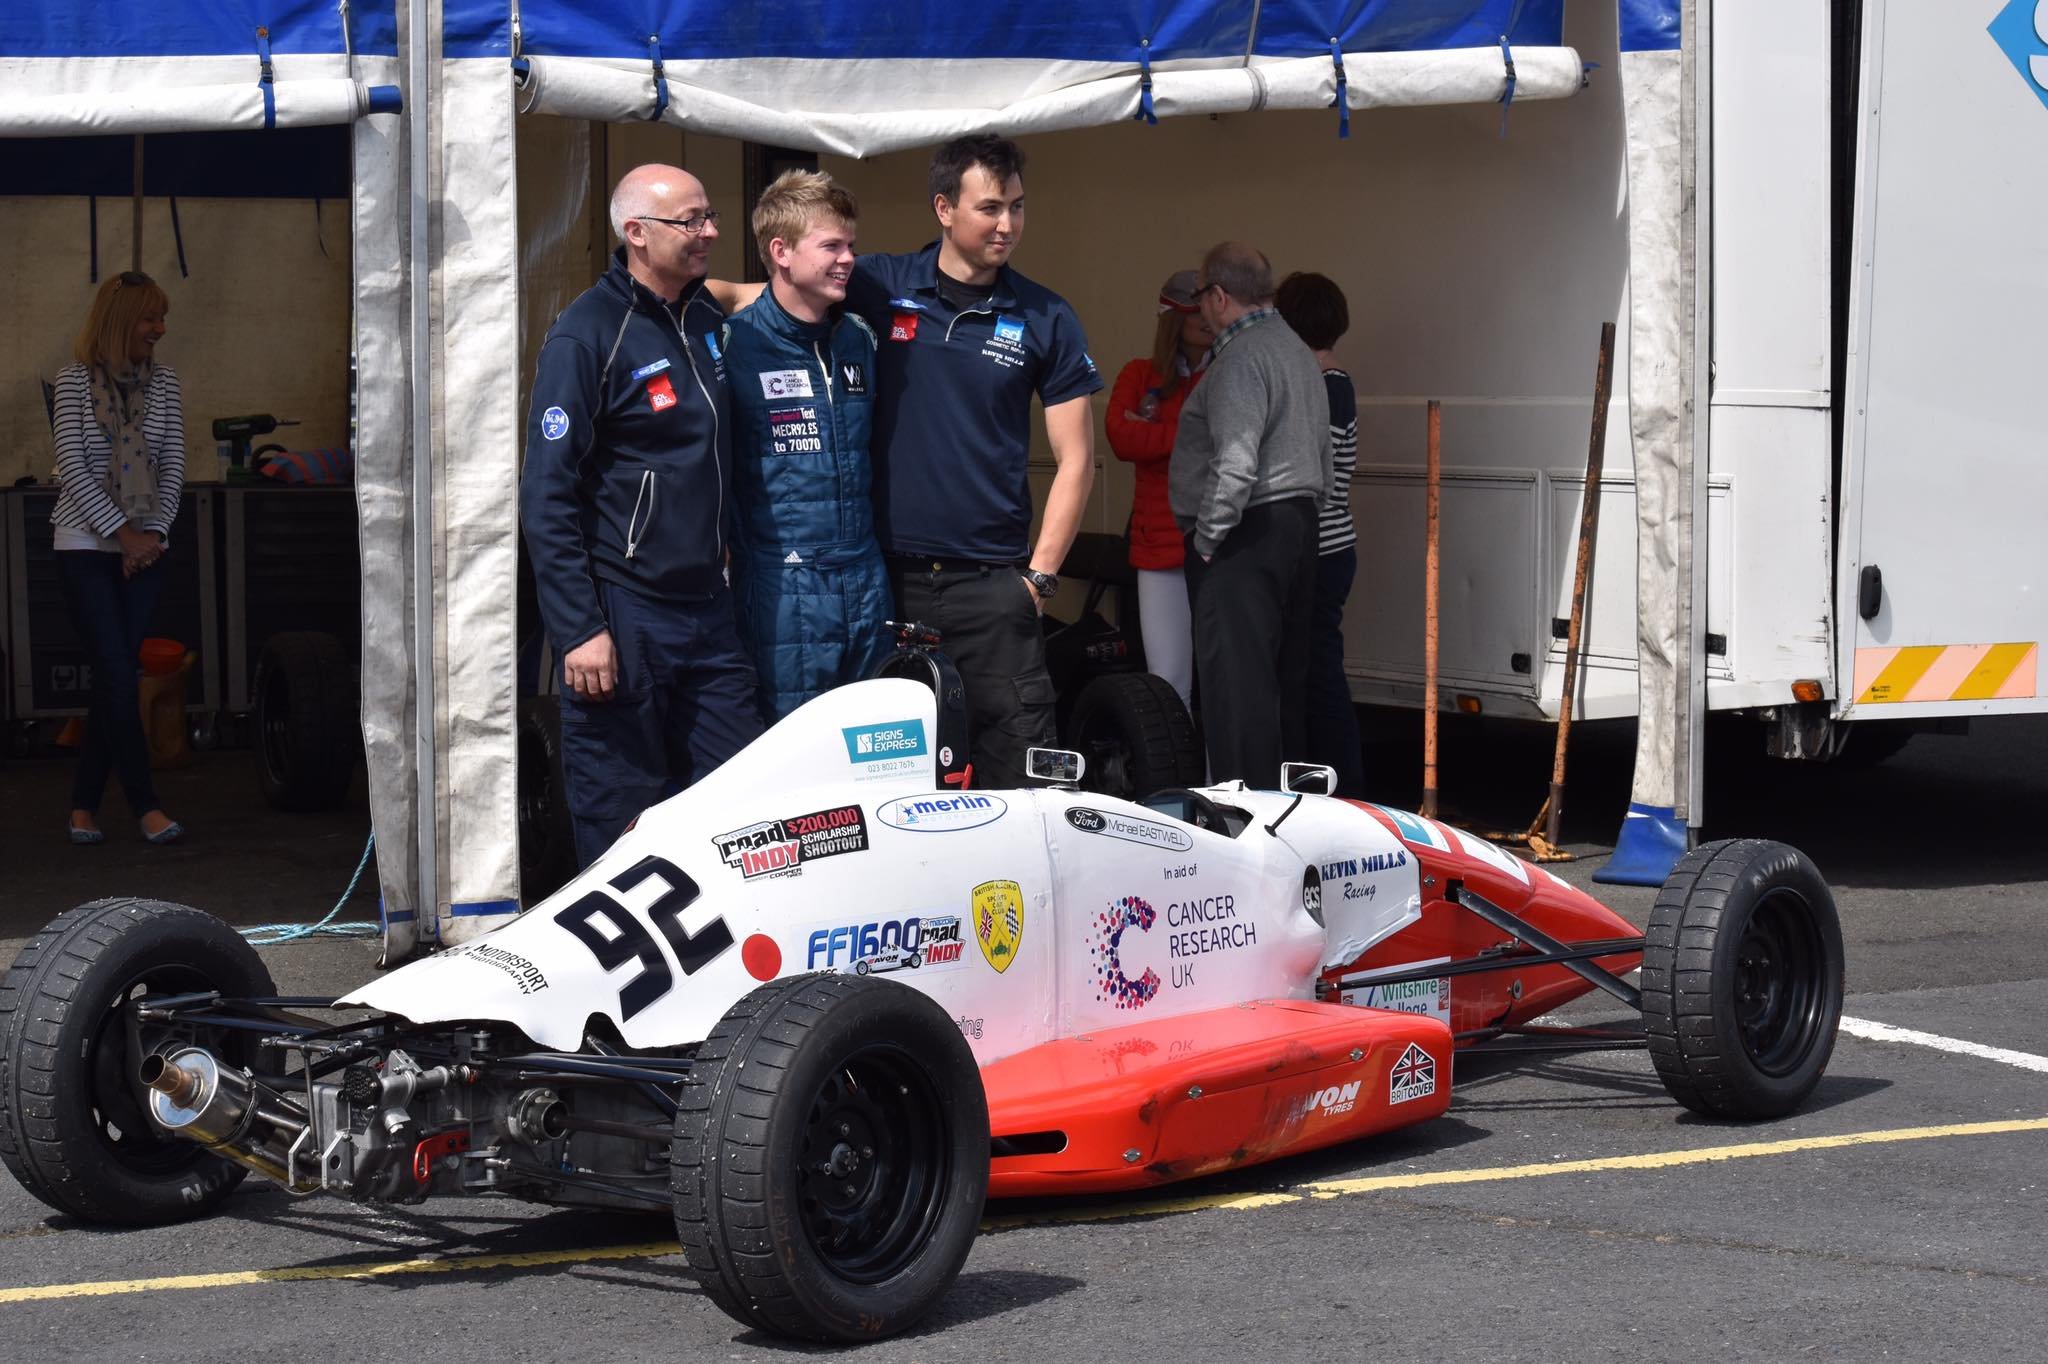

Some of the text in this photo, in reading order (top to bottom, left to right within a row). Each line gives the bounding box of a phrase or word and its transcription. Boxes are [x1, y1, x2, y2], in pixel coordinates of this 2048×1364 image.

[801, 407, 815, 420] Text
[772, 422, 818, 437] MECR92 £5
[774, 438, 820, 452] to 70070
[874, 729, 904, 743] SIGNS
[874, 737, 918, 752] EXPRESS
[868, 760, 916, 773] 023 8022 7676
[943, 750, 950, 762] E
[913, 794, 992, 814] merlin
[786, 808, 859, 835] $200,000
[1074, 810, 1186, 847] Ford Michael EASTWELL
[722, 821, 786, 857] road
[801, 824, 861, 845] SCHOLARSHIP
[804, 835, 864, 858] SHOOTOUT
[741, 841, 799, 876] INDY
[1321, 850, 1407, 882] KEVIN MILLS
[769, 867, 802, 880] COOPER
[1164, 863, 1198, 880] In aid of
[1304, 885, 1321, 910] ecs
[1342, 881, 1377, 901] Racing
[929, 915, 955, 927] mazda
[1167, 895, 1236, 928] CANCER
[554, 855, 735, 1023] 92
[807, 917, 920, 970] FF1600
[920, 921, 960, 944] road
[1169, 922, 1257, 959] RESEARCH
[873, 954, 899, 963] AVON
[927, 941, 964, 964] INDY
[465, 951, 531, 995] PHOTOGRAPHY
[474, 943, 549, 993] MOTORSPORT
[1171, 962, 1195, 989] UK
[1382, 979, 1437, 1002] Wiltshire
[1302, 1080, 1362, 1114] VON
[1391, 1081, 1434, 1104] BRITCOVER
[1322, 1101, 1355, 1117] TYRES
